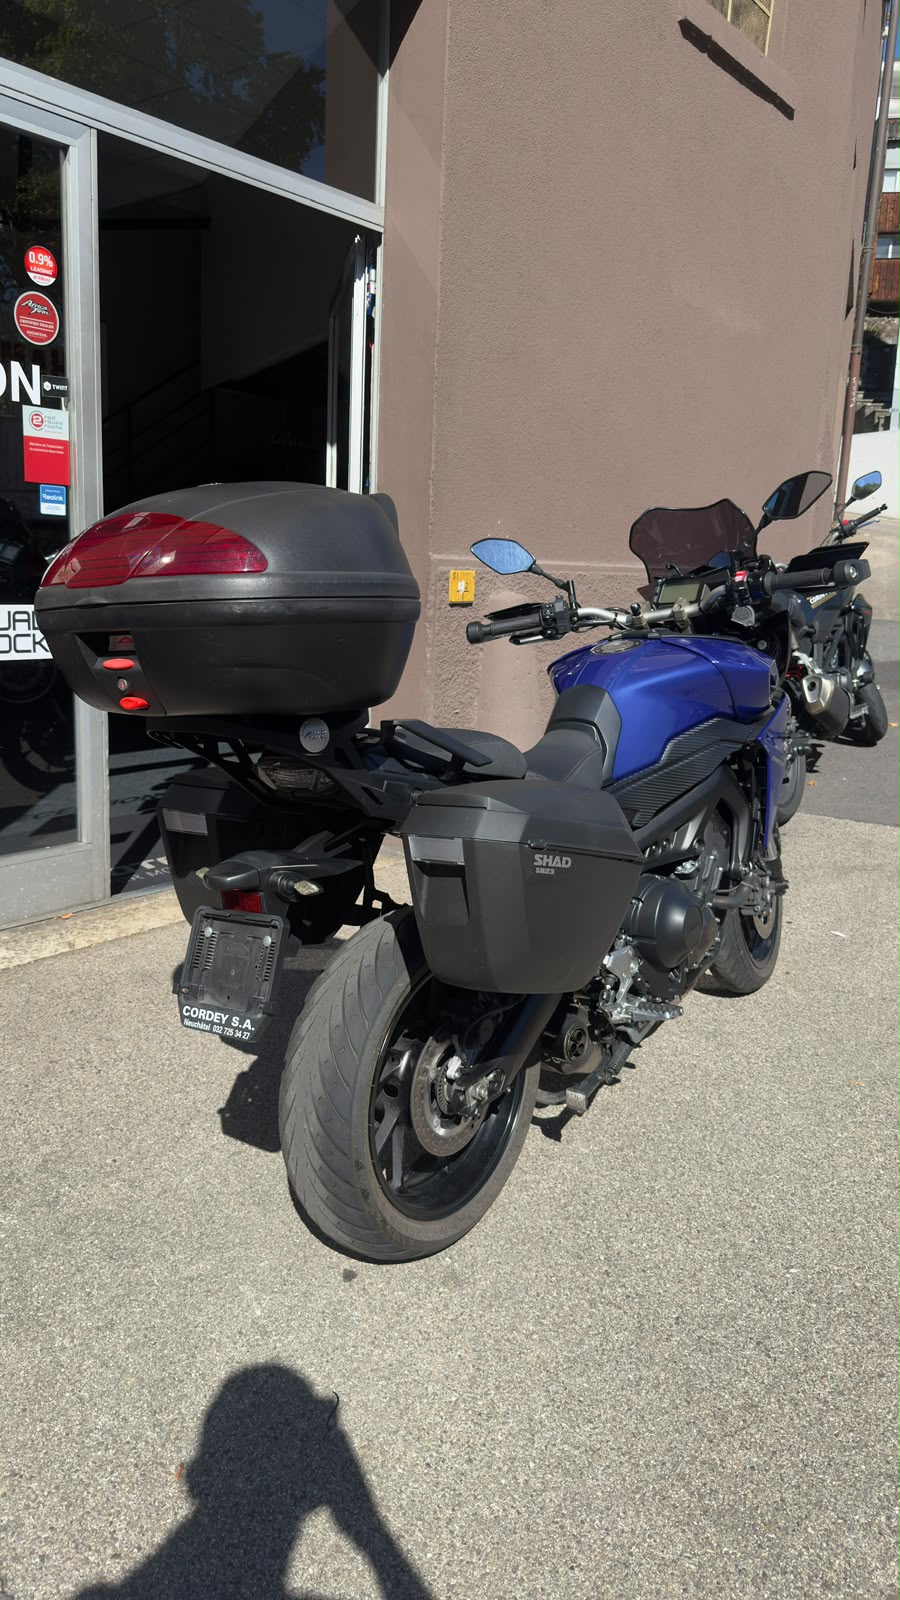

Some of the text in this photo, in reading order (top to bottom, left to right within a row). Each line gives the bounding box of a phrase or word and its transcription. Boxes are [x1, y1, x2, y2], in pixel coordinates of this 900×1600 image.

[29, 251, 54, 268] 0.9%
[30, 265, 53, 275] LEASING
[0, 360, 41, 406] N
[533, 853, 572, 868] SHAD
[182, 1005, 256, 1031] CORDEY S.A.
[183, 1017, 251, 1040] Neuchâtel 032 725 34 27
